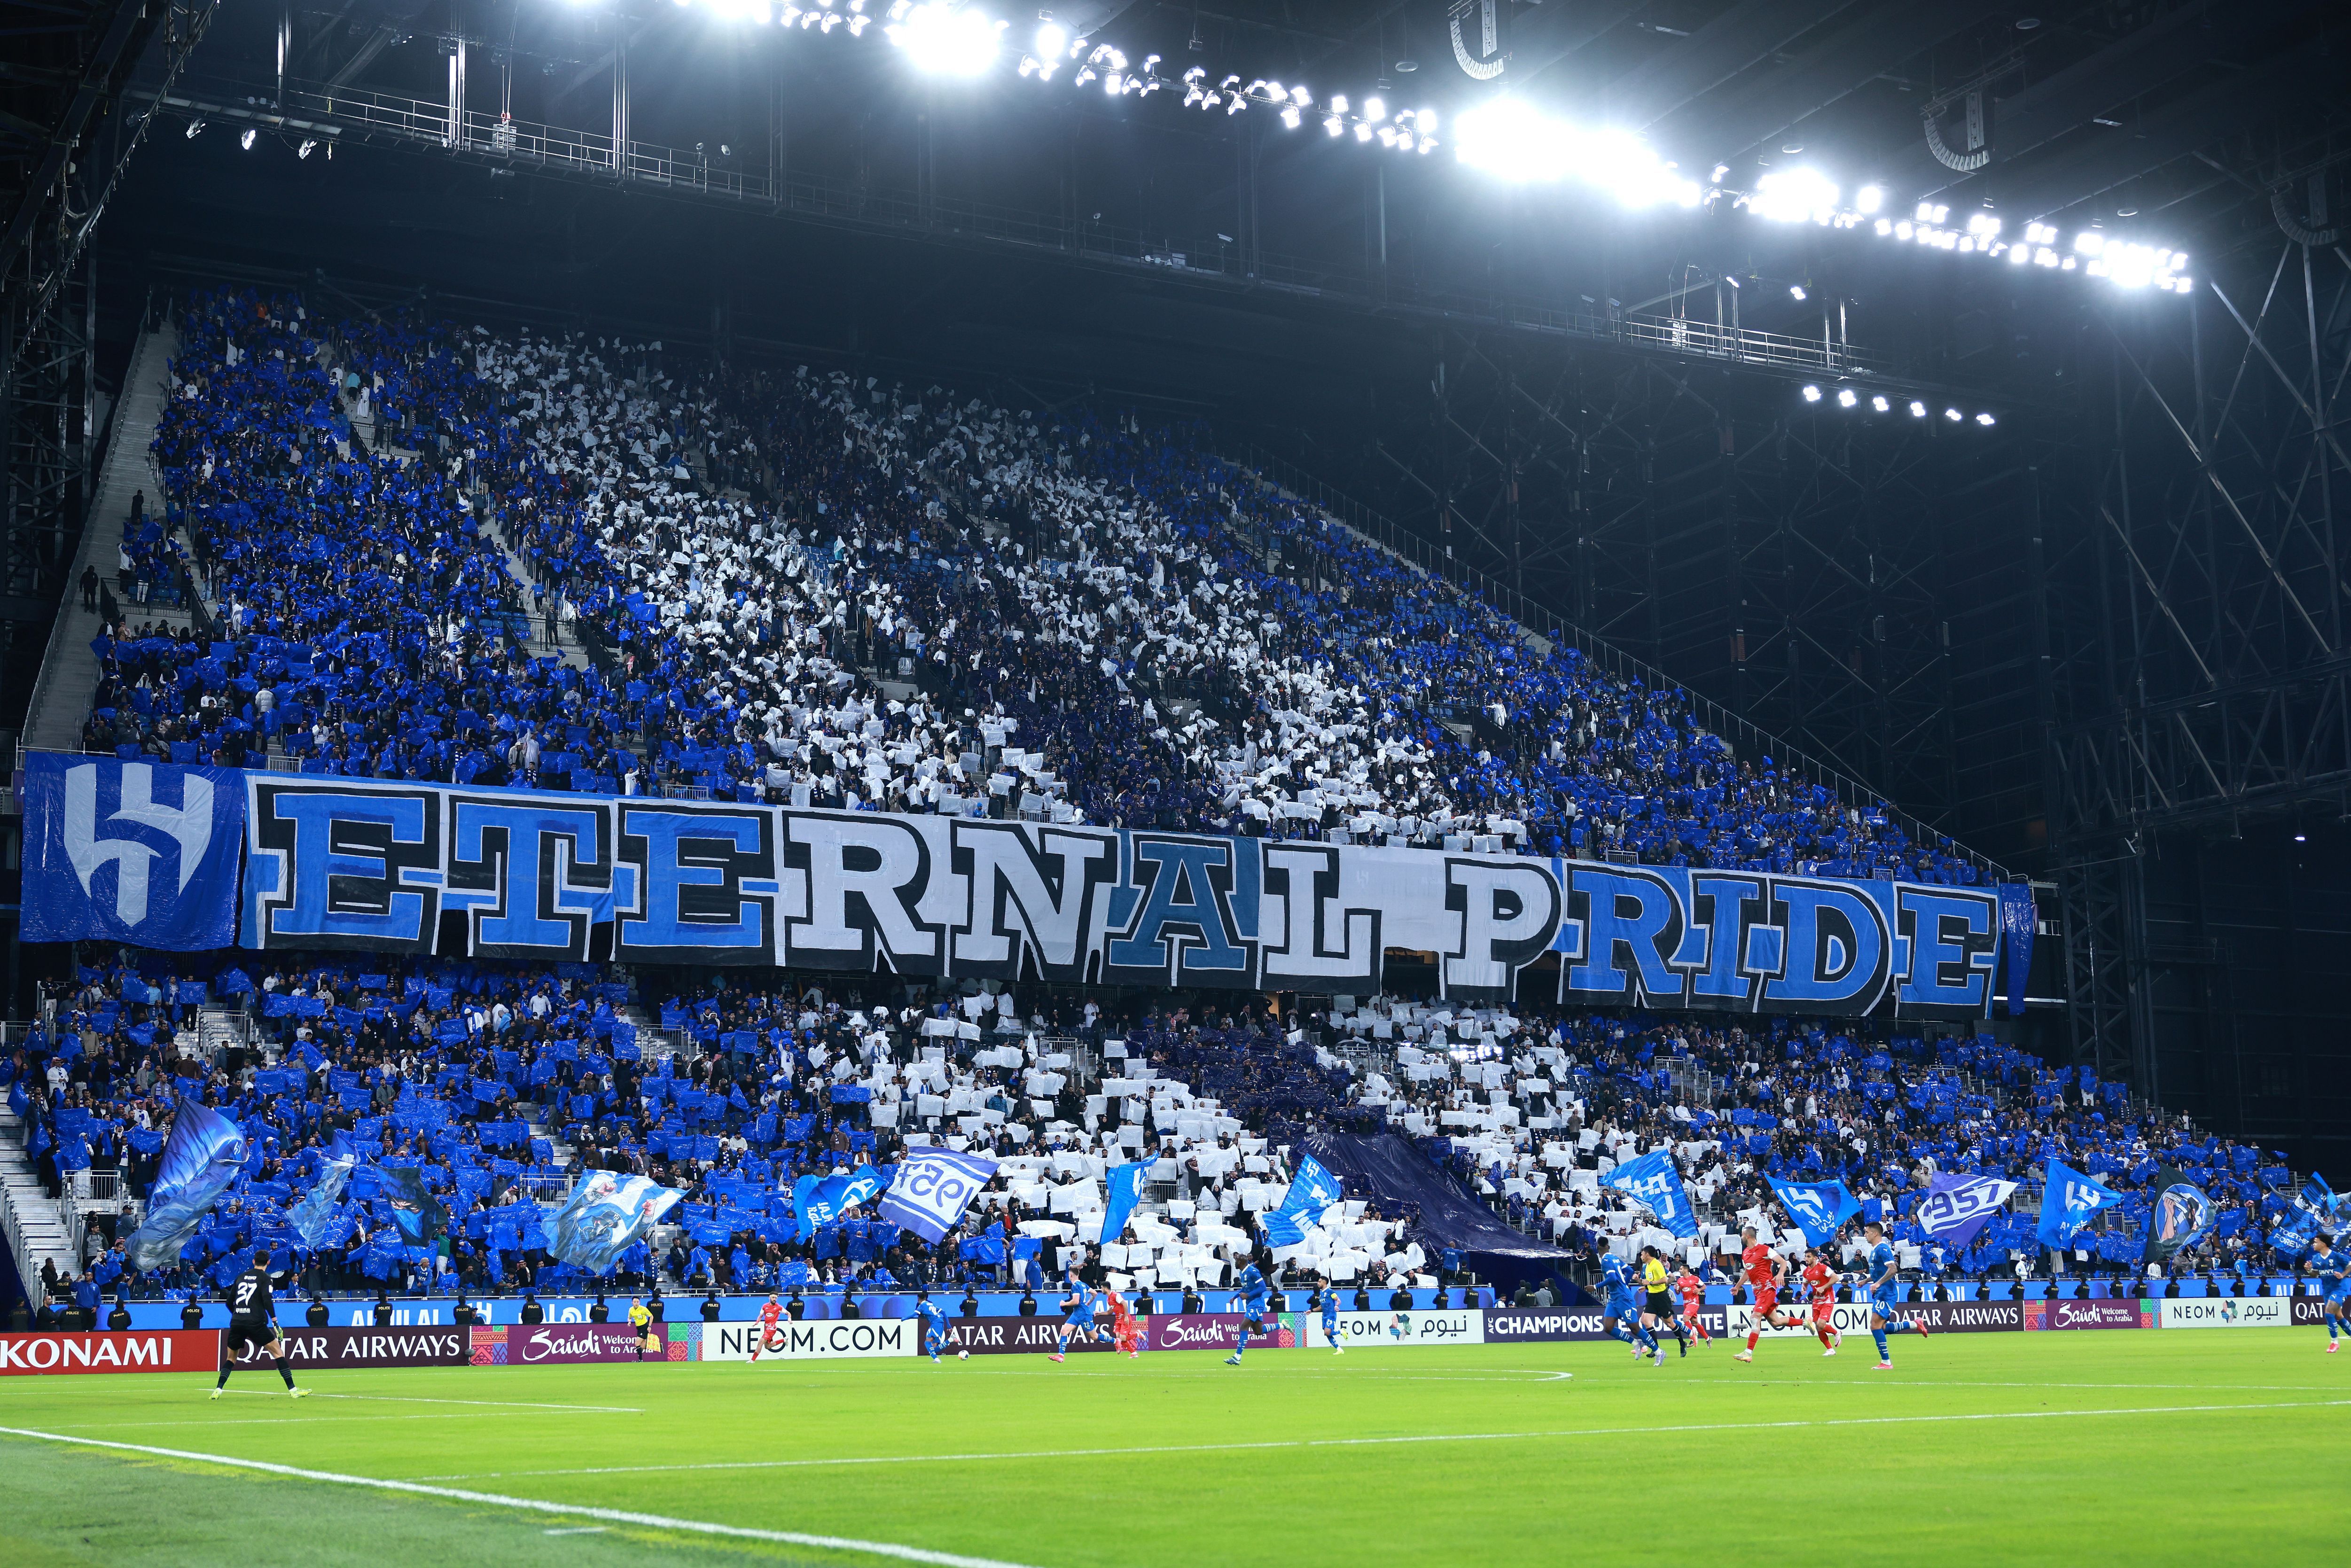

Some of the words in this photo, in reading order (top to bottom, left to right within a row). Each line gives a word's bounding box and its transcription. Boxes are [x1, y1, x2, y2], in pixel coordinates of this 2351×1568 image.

[272, 793, 1372, 976] ETERNAL
[1446, 864, 1990, 1005] PRIDE
[2274, 1233, 2303, 1249] FOREV
[236, 1282, 257, 1306] 37
[1625, 1309, 1632, 1318] 87
[1875, 1299, 1885, 1310] 20
[2174, 1305, 2215, 1319] NEOM
[2244, 1302, 2279, 1321] نيوم
[2296, 1303, 2325, 1321] QAT
[1495, 1315, 1604, 1334] CHAMPIONS
[1949, 1307, 2019, 1326] AIRWAYS
[1340, 1319, 1381, 1336] EOM
[1421, 1315, 1467, 1338] نيوم
[0, 1337, 172, 1368] KONAMI
[341, 1333, 460, 1358] AIRWAYS
[610, 1345, 621, 1354] to
